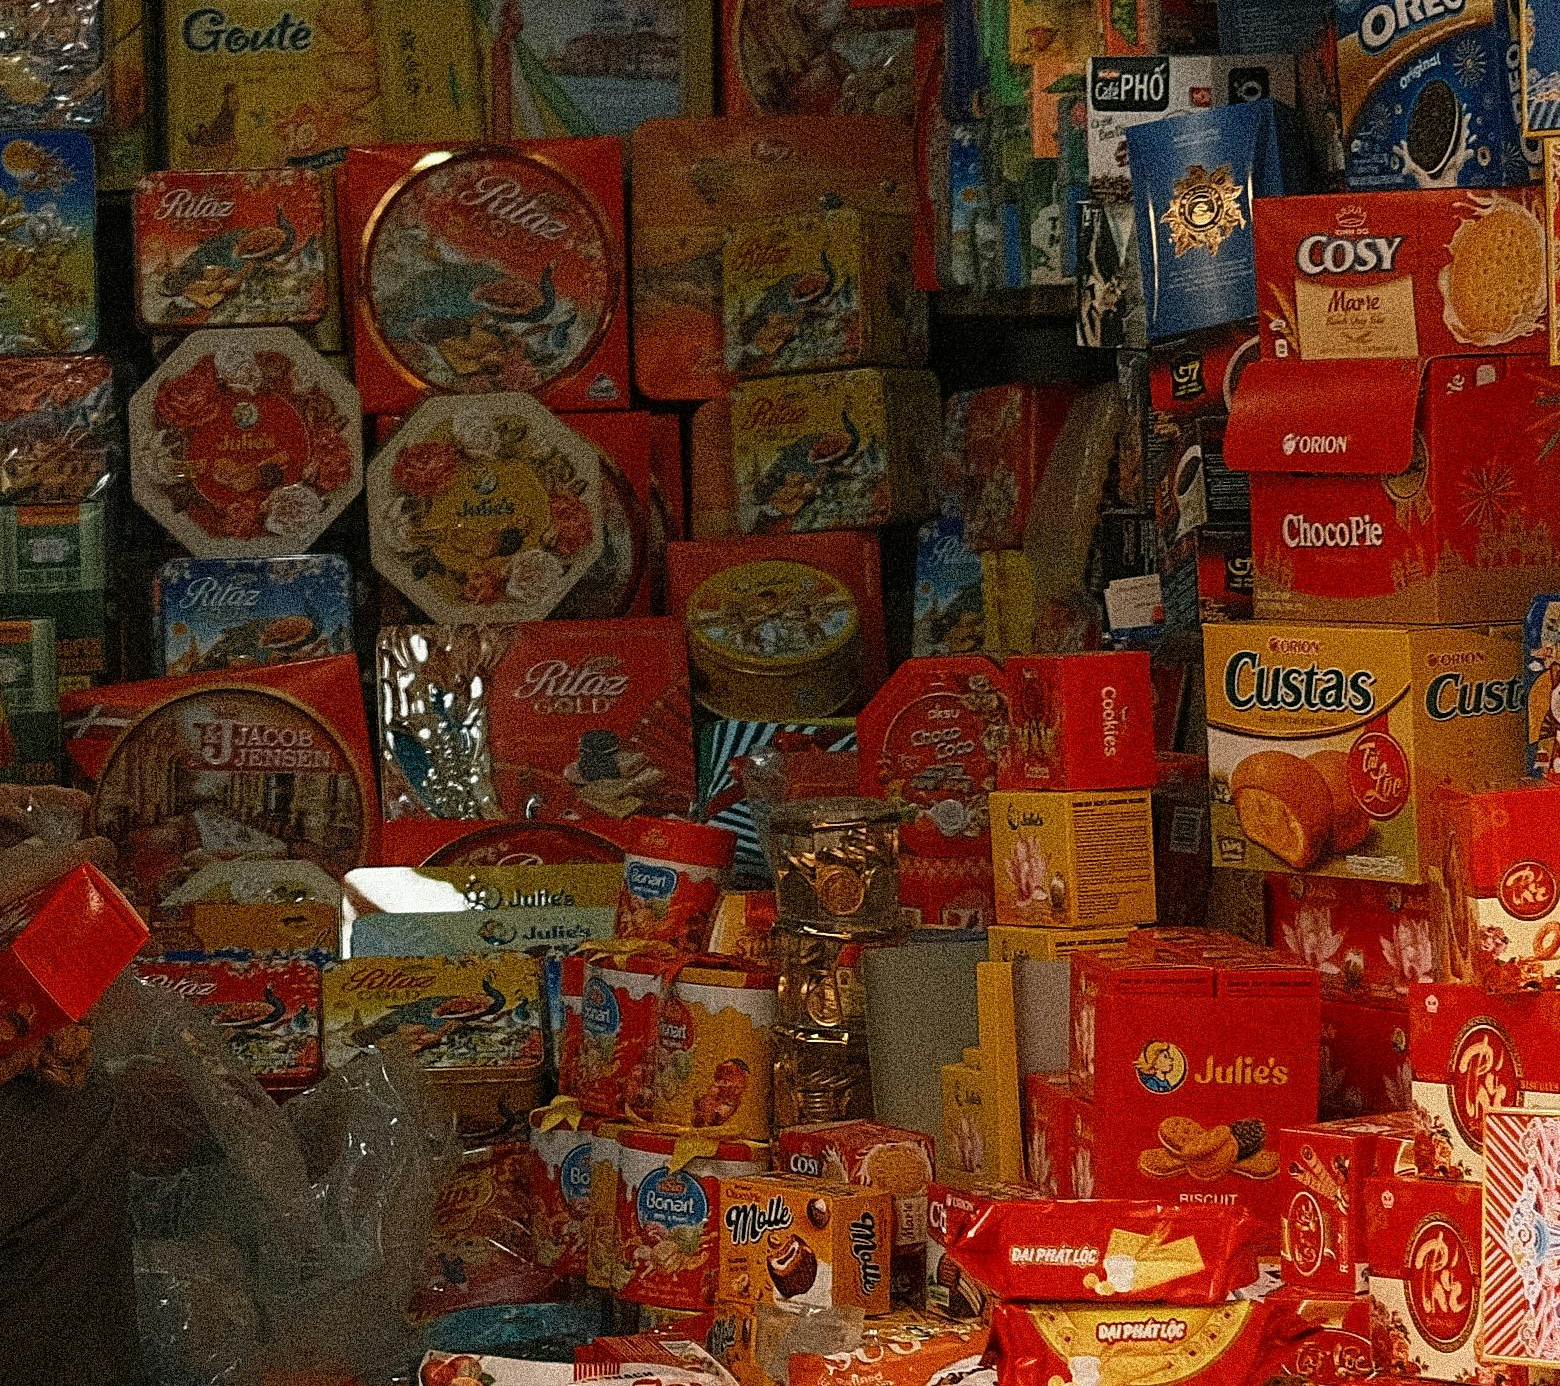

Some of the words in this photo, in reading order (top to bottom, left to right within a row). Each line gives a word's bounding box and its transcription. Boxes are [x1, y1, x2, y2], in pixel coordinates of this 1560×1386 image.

[159, 189, 236, 220] Ritaz
[459, 173, 569, 240] Ritaz
[1295, 233, 1404, 277] COSY
[1298, 435, 1348, 454] ORION
[1279, 639, 1320, 654] ORION
[513, 657, 630, 701] Ritaz
[1224, 651, 1378, 715] Custas
[236, 727, 314, 749] JACOB
[235, 747, 331, 770] JENSEN
[507, 889, 576, 910] Julie's
[521, 922, 593, 941] Julie's
[1193, 1054, 1291, 1086] Julie's
[646, 1191, 696, 1216] Bonart
[1179, 1192, 1239, 1207] BISCUIT
